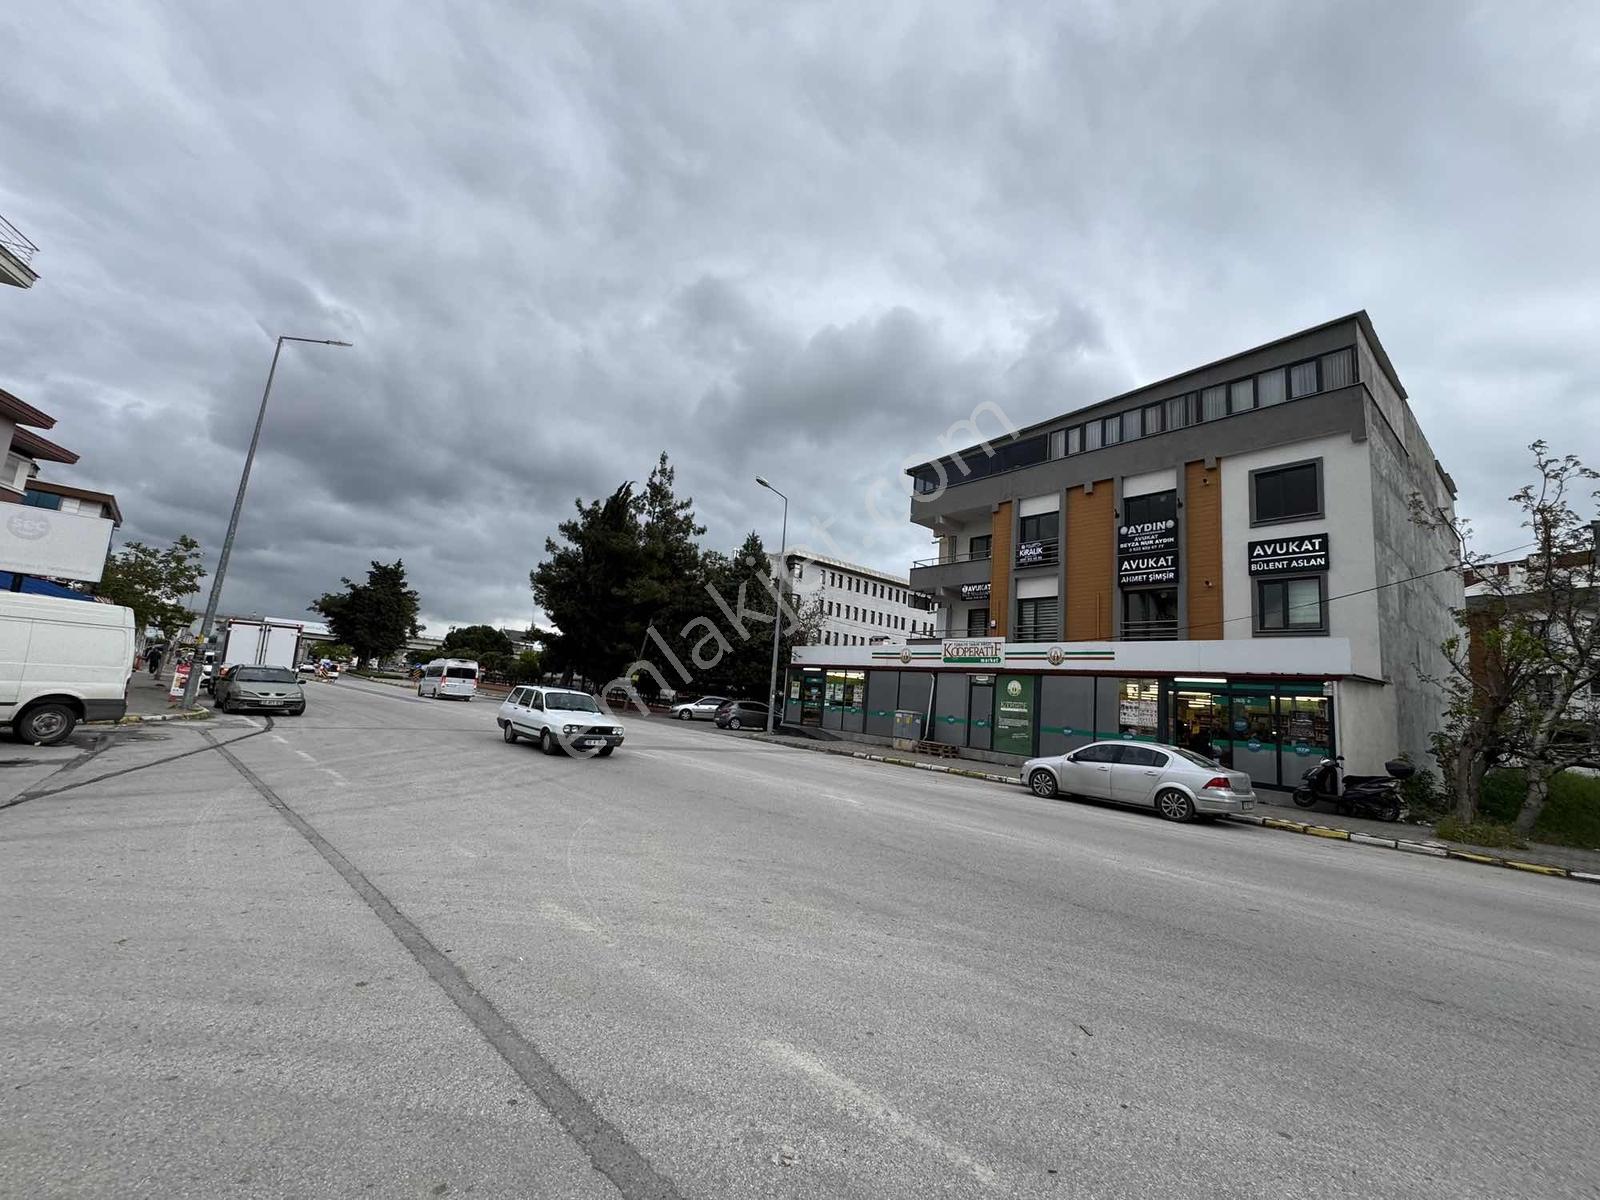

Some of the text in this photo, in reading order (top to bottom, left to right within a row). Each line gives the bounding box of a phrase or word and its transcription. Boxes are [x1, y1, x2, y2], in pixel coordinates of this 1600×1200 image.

[1128, 521, 1166, 534] AYDIN
[1253, 539, 1322, 556] AVUKAT
[1121, 555, 1174, 570] AVUKAT
[1251, 557, 1325, 571] BÜLENT ASLAN
[1121, 571, 1174, 583] AHMET ŞİMŞİR
[967, 584, 991, 592] AVUKAT
